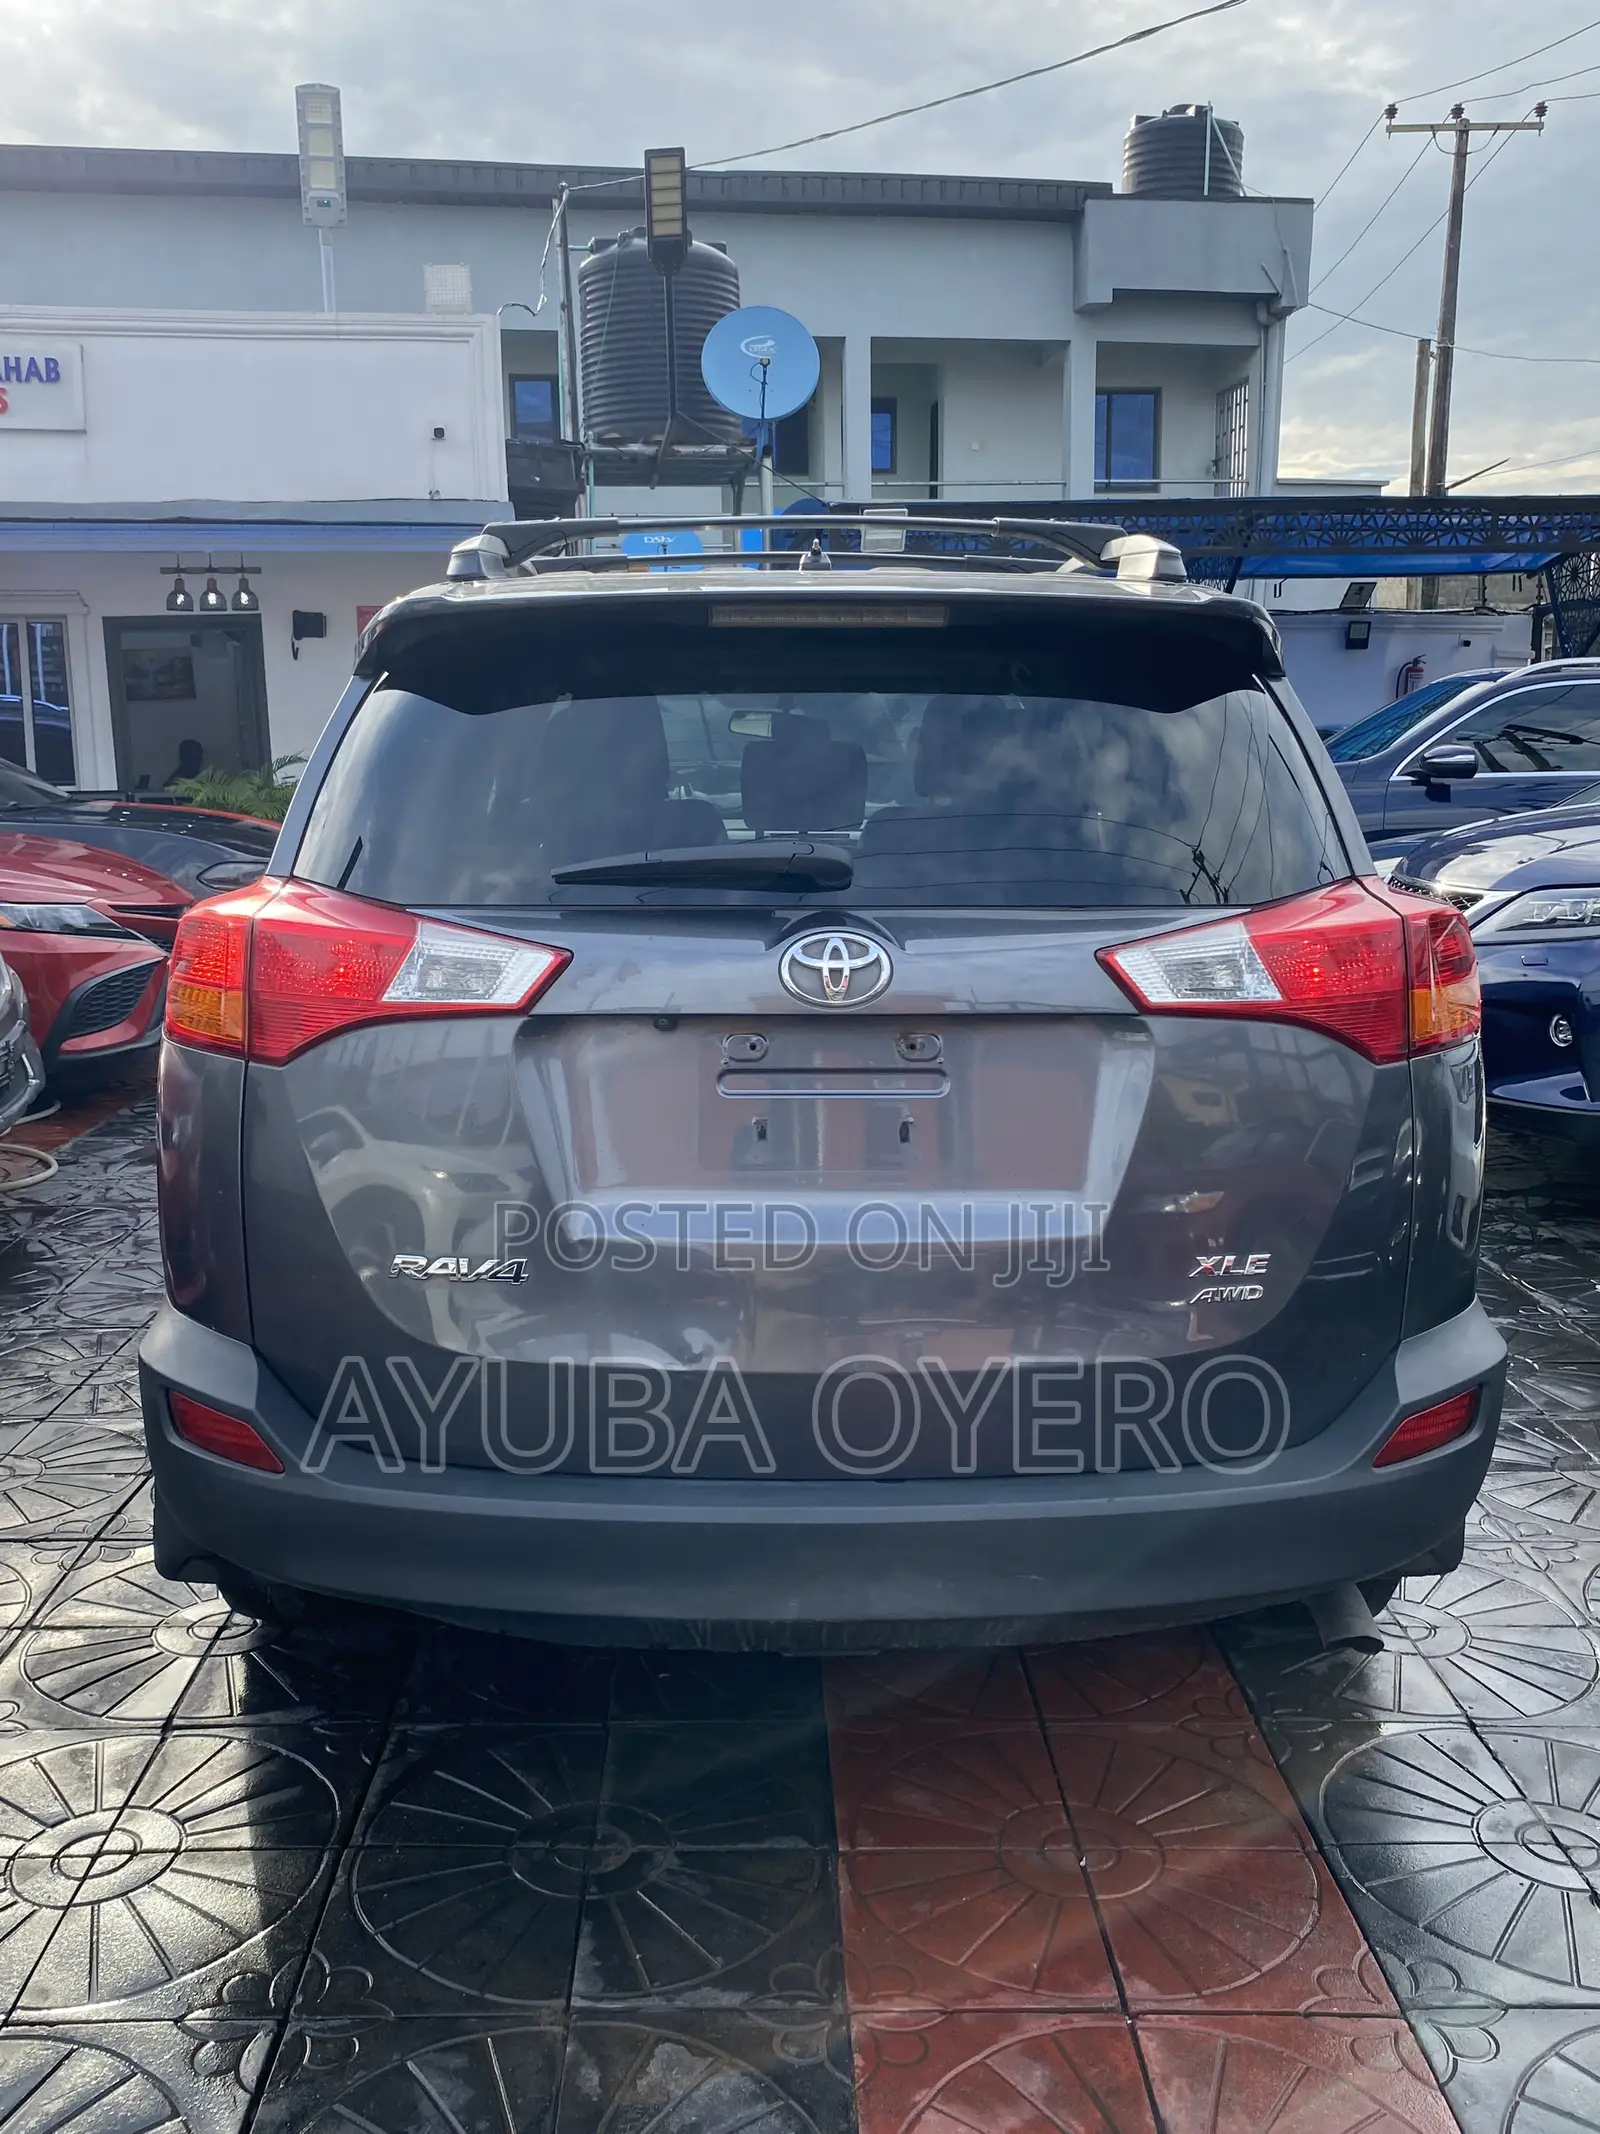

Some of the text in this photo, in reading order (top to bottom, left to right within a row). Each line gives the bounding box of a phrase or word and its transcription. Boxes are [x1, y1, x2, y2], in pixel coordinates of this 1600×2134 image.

[0, 356, 61, 383] HAB
[388, 1254, 529, 1285] RAV4
[1188, 1253, 1272, 1278] XLE
[1189, 1284, 1264, 1304] AWD
